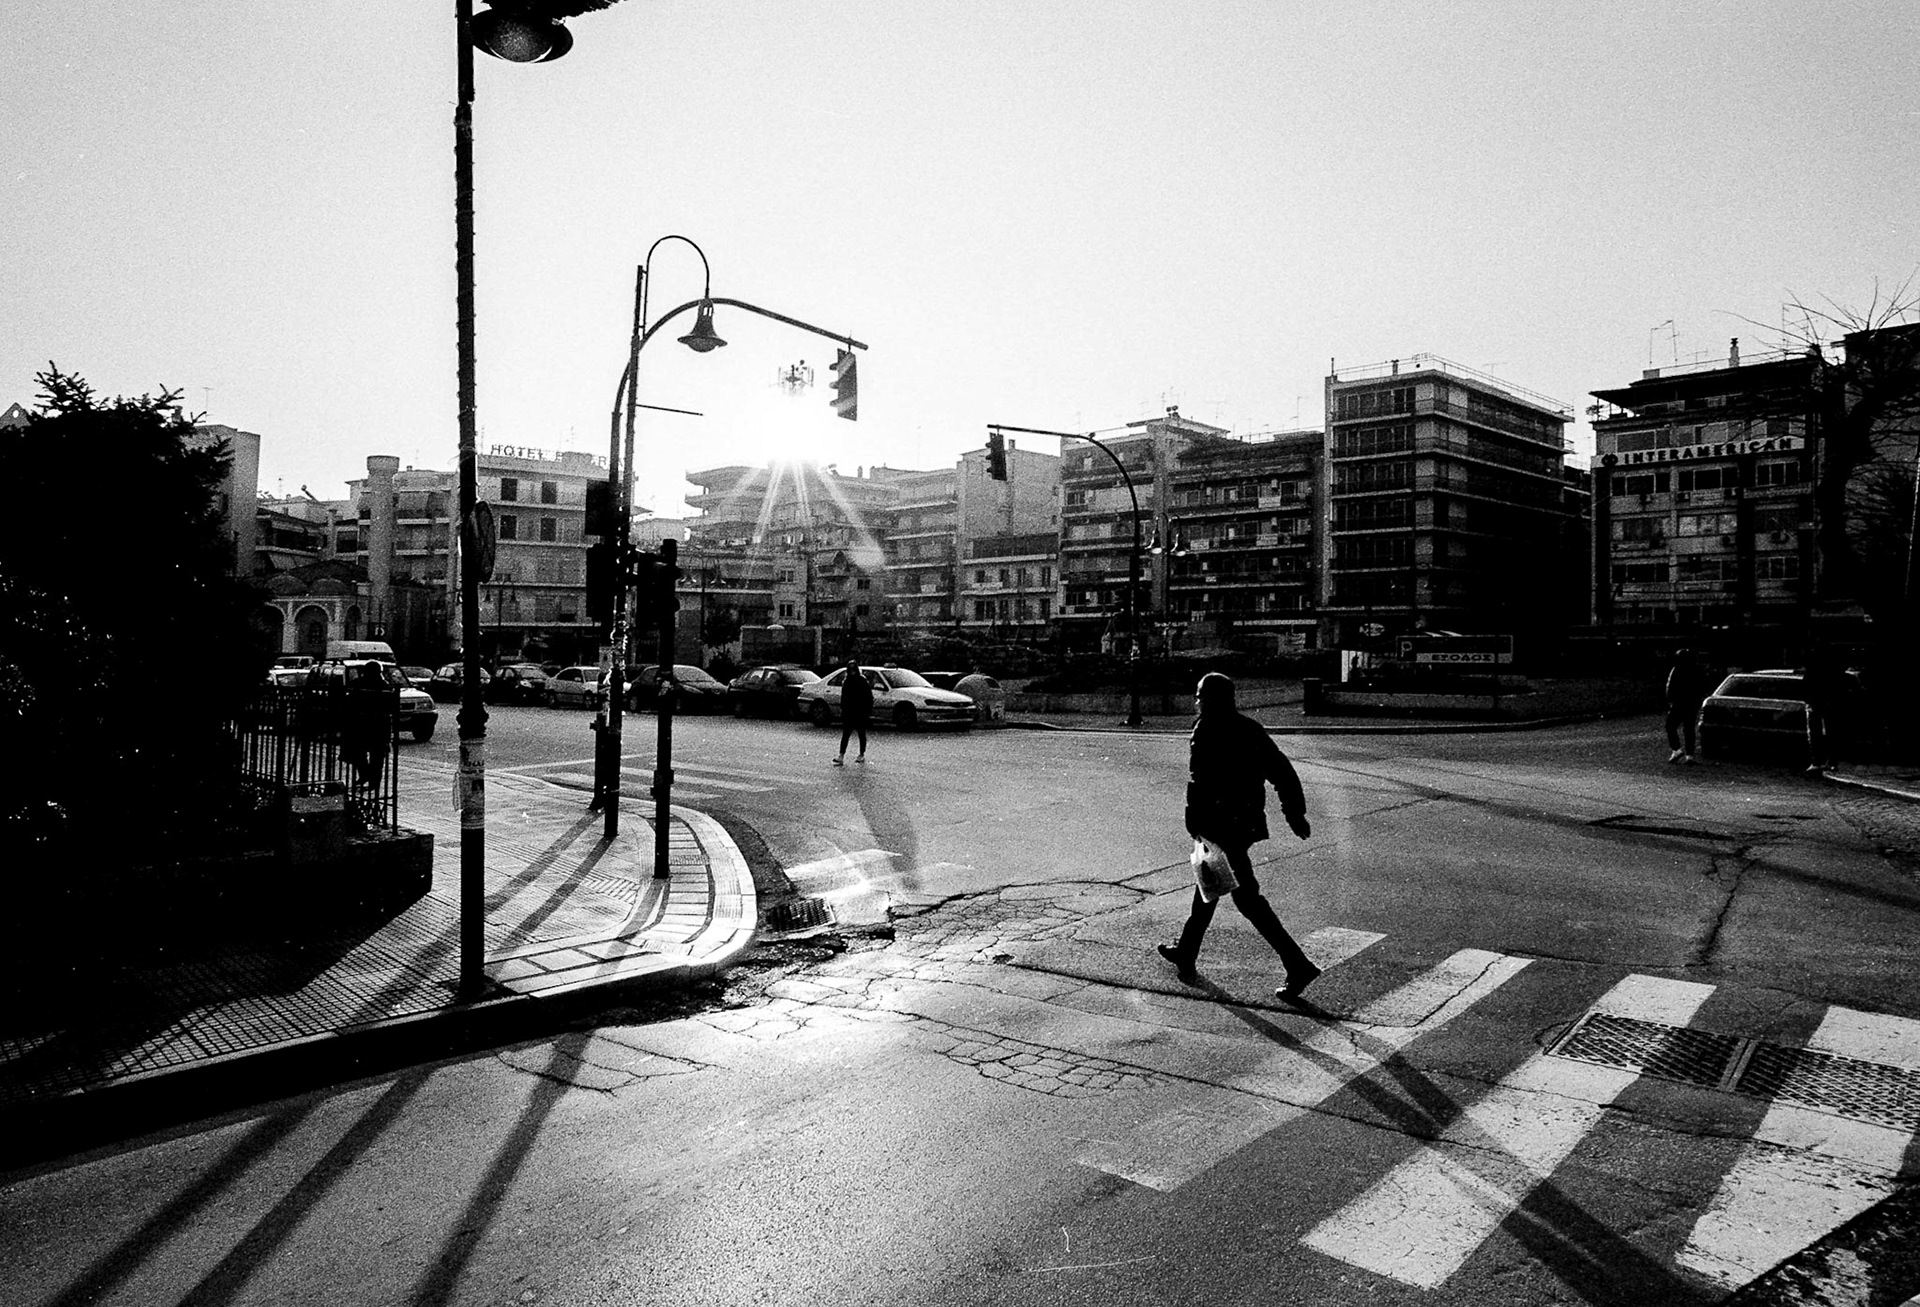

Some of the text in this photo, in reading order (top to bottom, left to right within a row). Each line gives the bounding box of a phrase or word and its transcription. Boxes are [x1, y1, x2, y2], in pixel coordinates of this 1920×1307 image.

[491, 444, 546, 460] HOTEL
[1624, 438, 1792, 464] INTERAMERICAN
[1401, 641, 1412, 657] P
